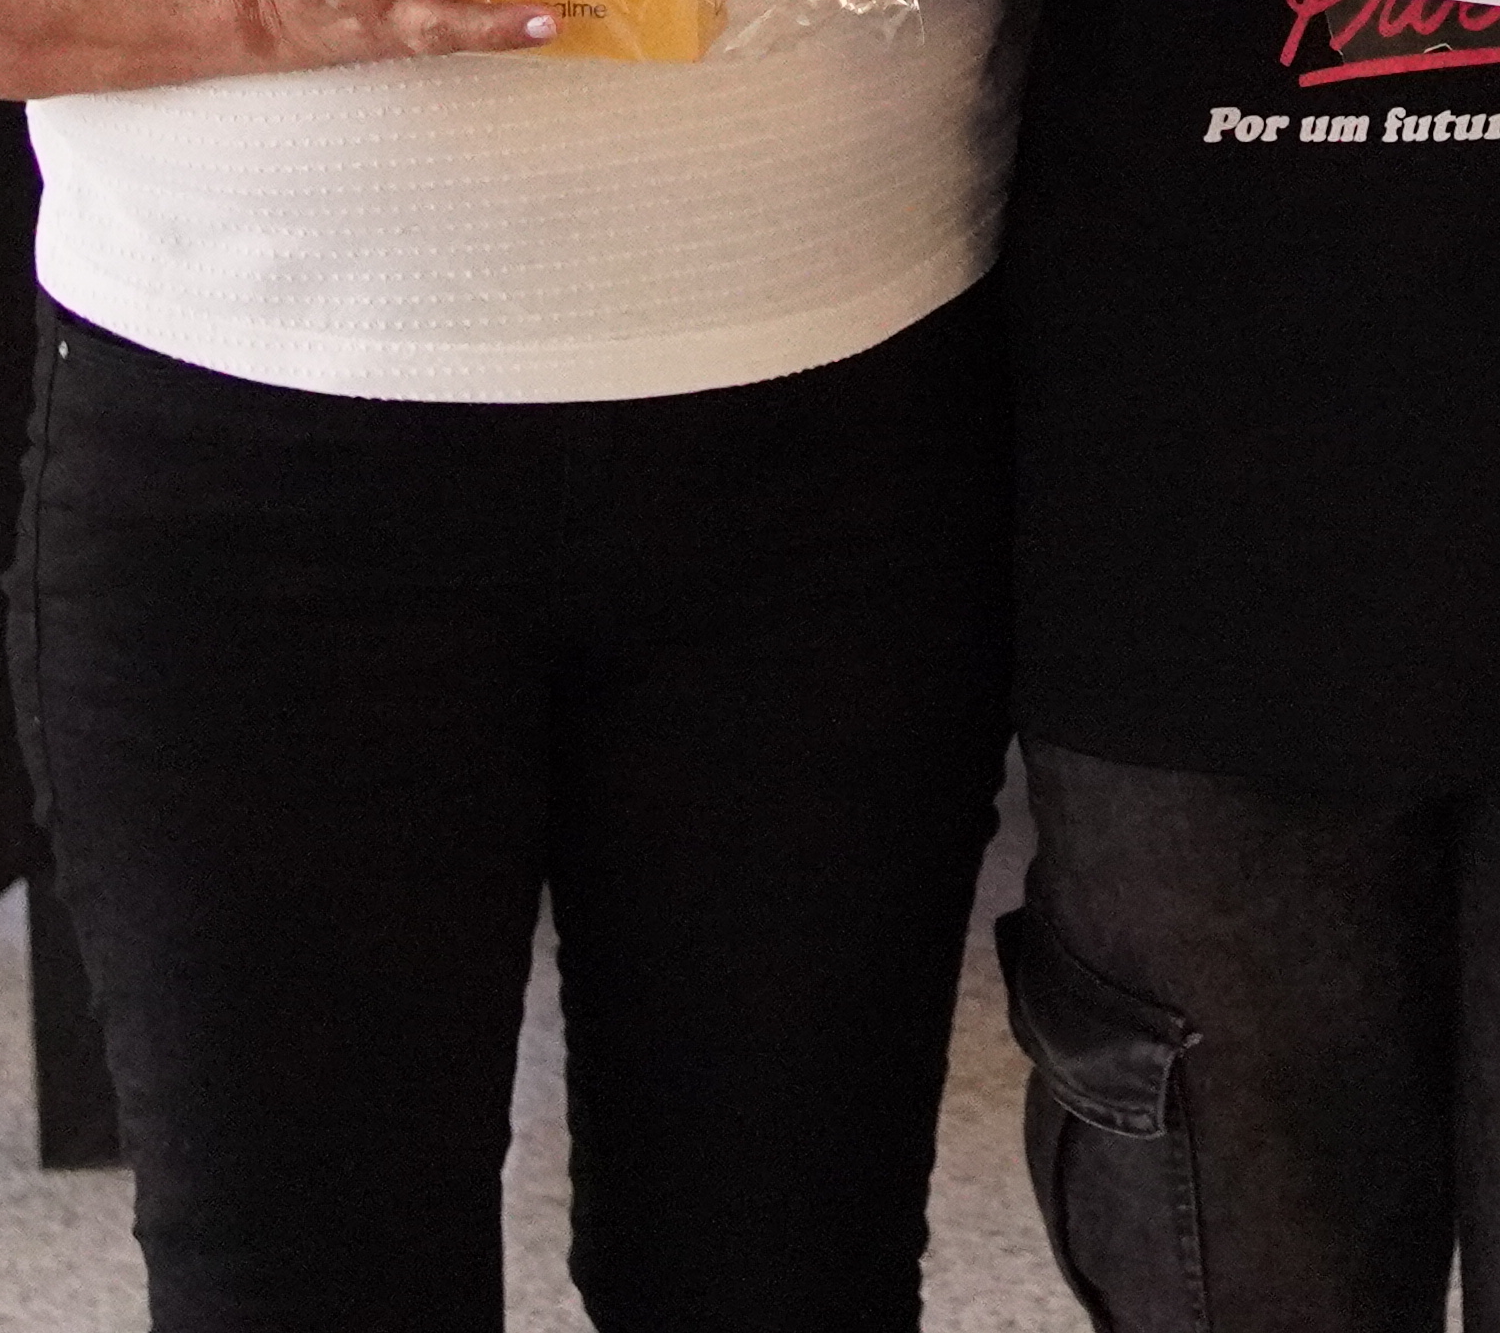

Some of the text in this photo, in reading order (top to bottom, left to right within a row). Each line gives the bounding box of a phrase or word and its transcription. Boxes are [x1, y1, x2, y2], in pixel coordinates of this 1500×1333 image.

[547, 0, 607, 18] alme
[1203, 106, 1291, 143] Por
[1299, 116, 1368, 143] um
